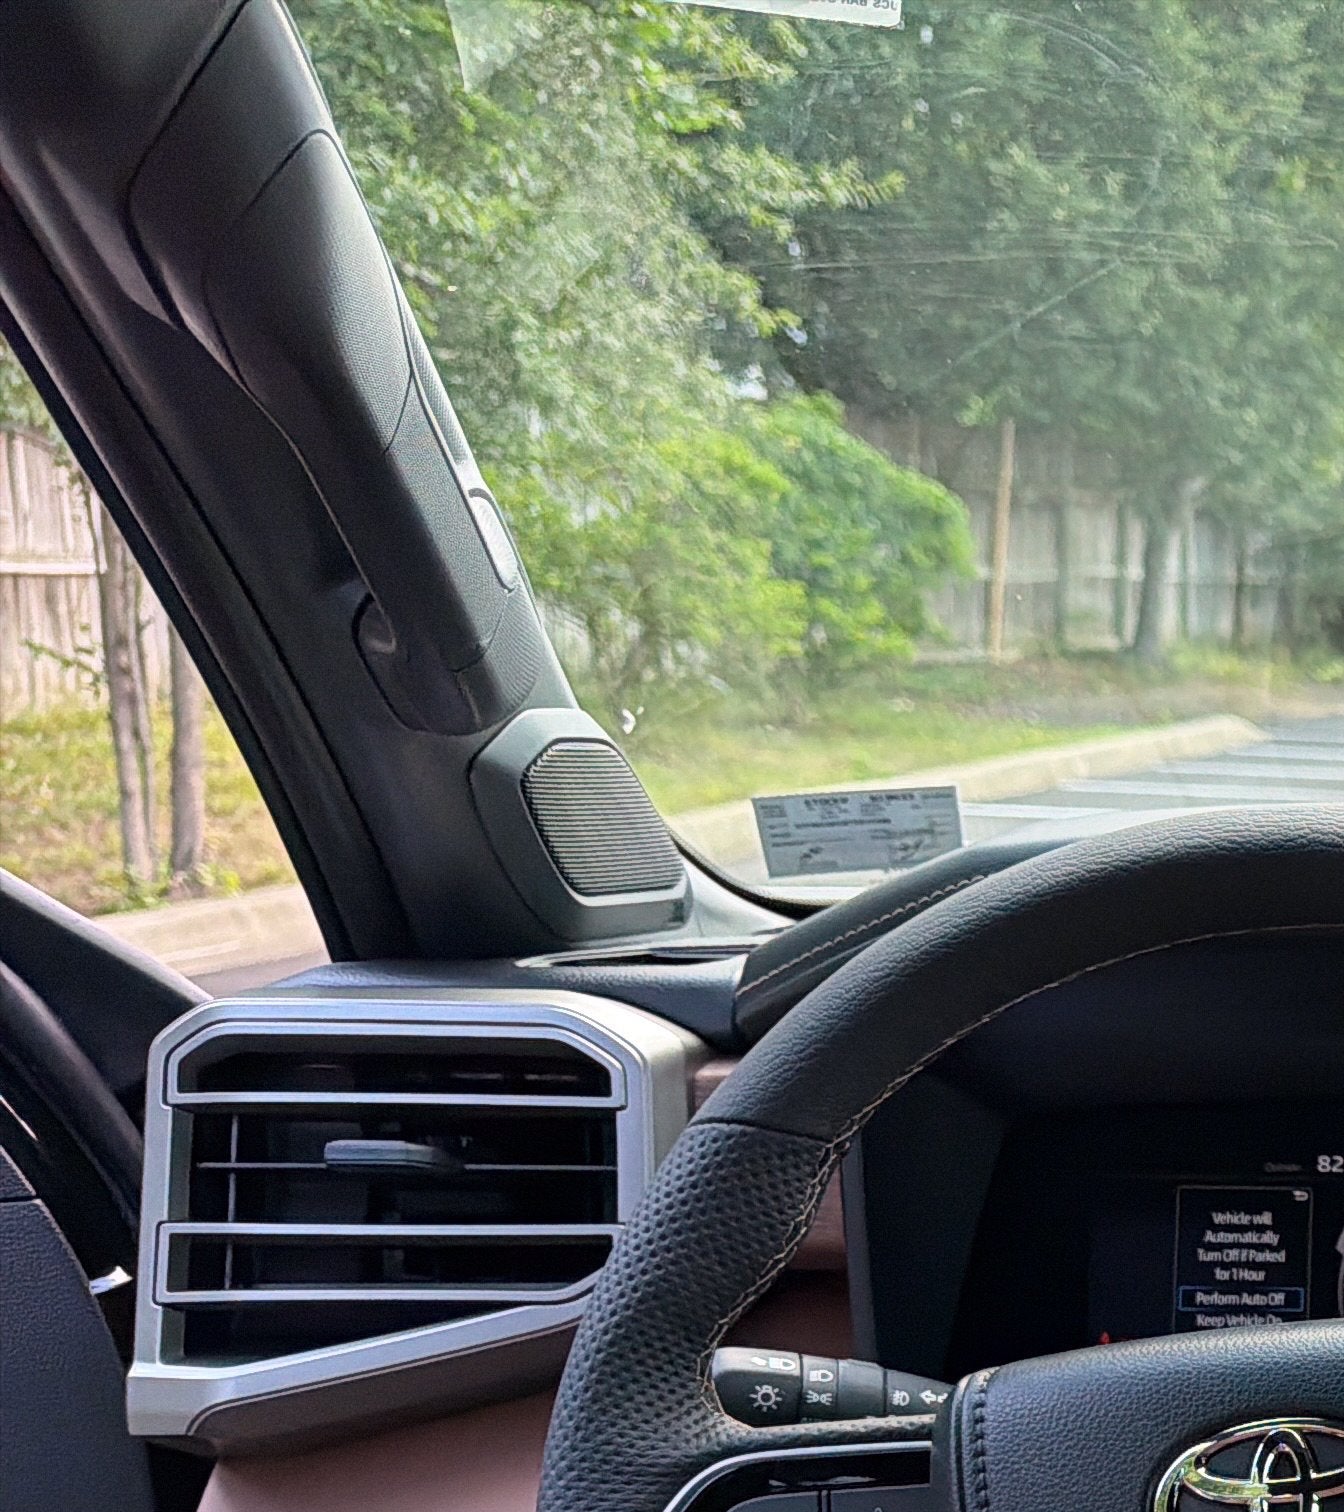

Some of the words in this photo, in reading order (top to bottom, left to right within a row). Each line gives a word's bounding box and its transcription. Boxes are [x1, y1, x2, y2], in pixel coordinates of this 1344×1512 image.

[1212, 1210, 1251, 1226] Vehicle
[1252, 1210, 1273, 1226] will
[1203, 1230, 1280, 1246] Automatically
[1197, 1248, 1222, 1262] Turn
[1222, 1248, 1240, 1262] Off
[1240, 1249, 1248, 1262] if
[1249, 1249, 1286, 1263] Parked
[1214, 1268, 1231, 1281] for
[1232, 1268, 1238, 1281] 1
[1238, 1268, 1266, 1281] Hour
[1196, 1292, 1238, 1306] Perform
[1241, 1292, 1267, 1306] Auto
[1268, 1292, 1285, 1306] Off
[1196, 1314, 1225, 1328] Keep
[1226, 1313, 1265, 1326] Vehicle
